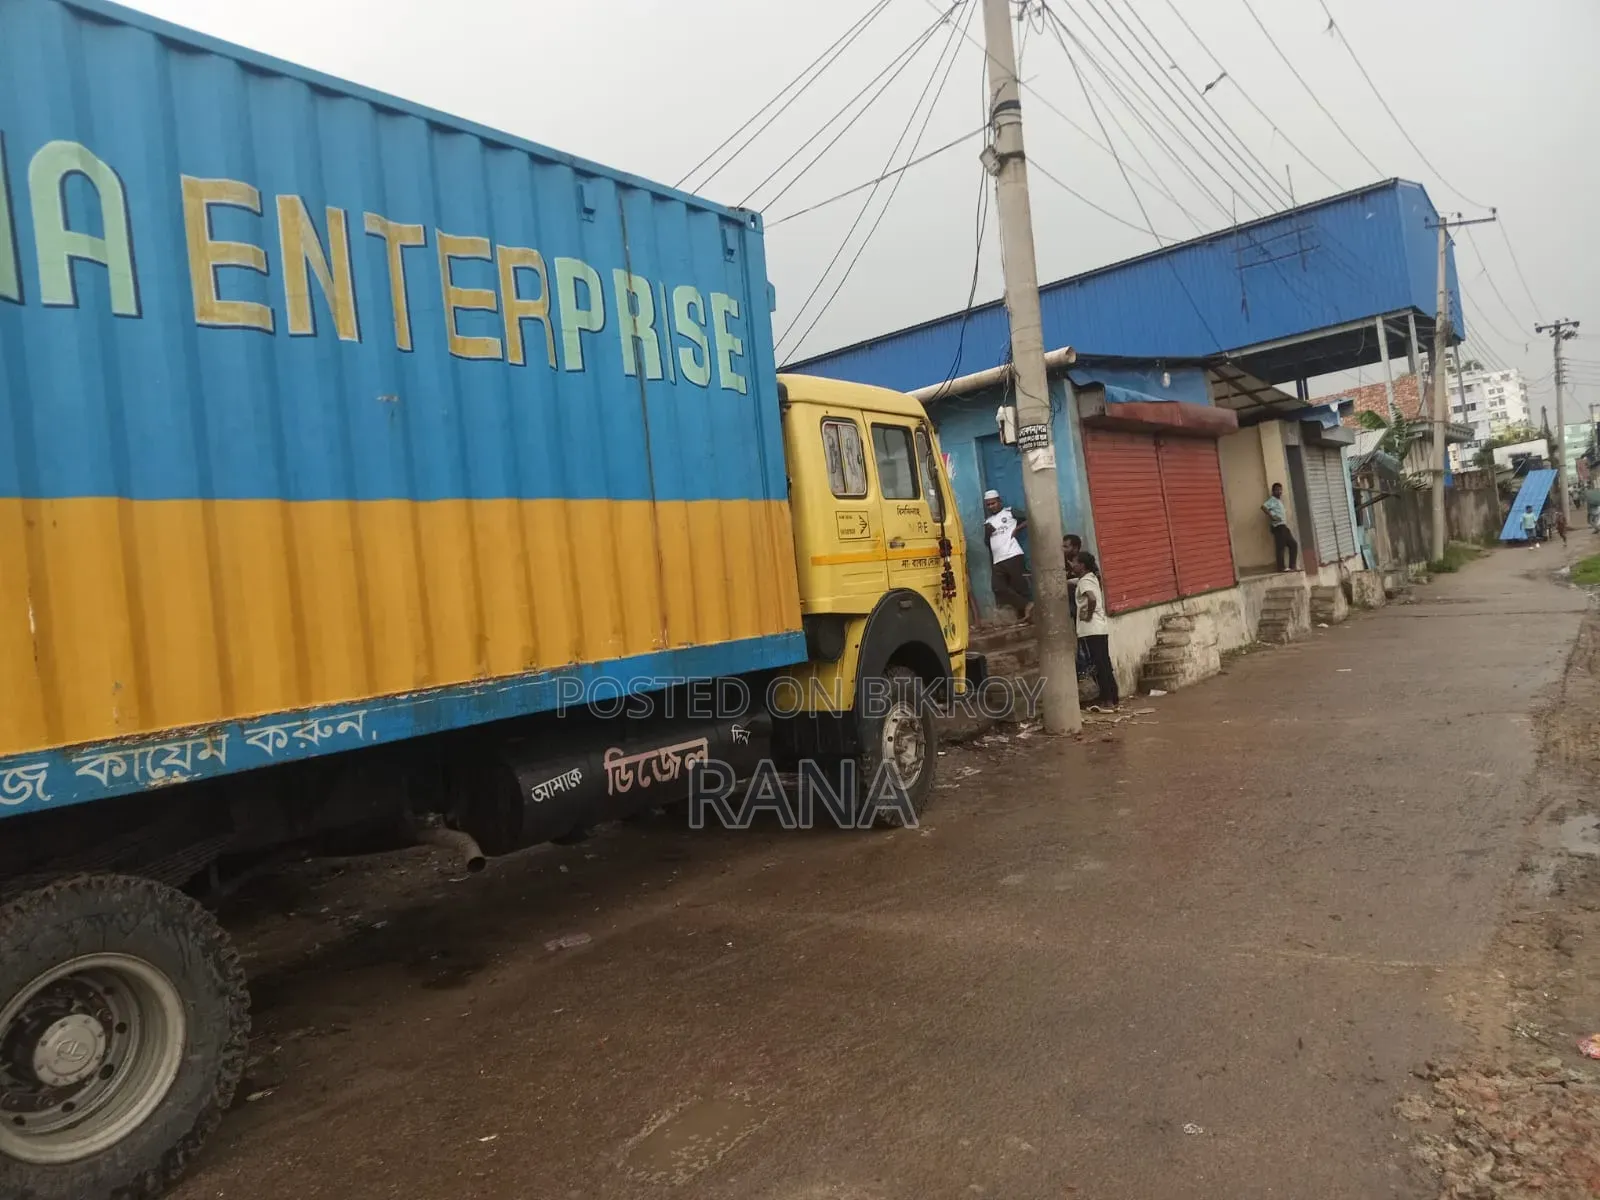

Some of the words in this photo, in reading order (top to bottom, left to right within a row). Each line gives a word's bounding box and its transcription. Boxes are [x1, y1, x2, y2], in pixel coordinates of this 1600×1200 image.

[0, 130, 142, 319] A
[180, 173, 748, 395] ENTERPRISE
[531, 767, 584, 802] আমাকে
[731, 724, 752, 746] দিন
